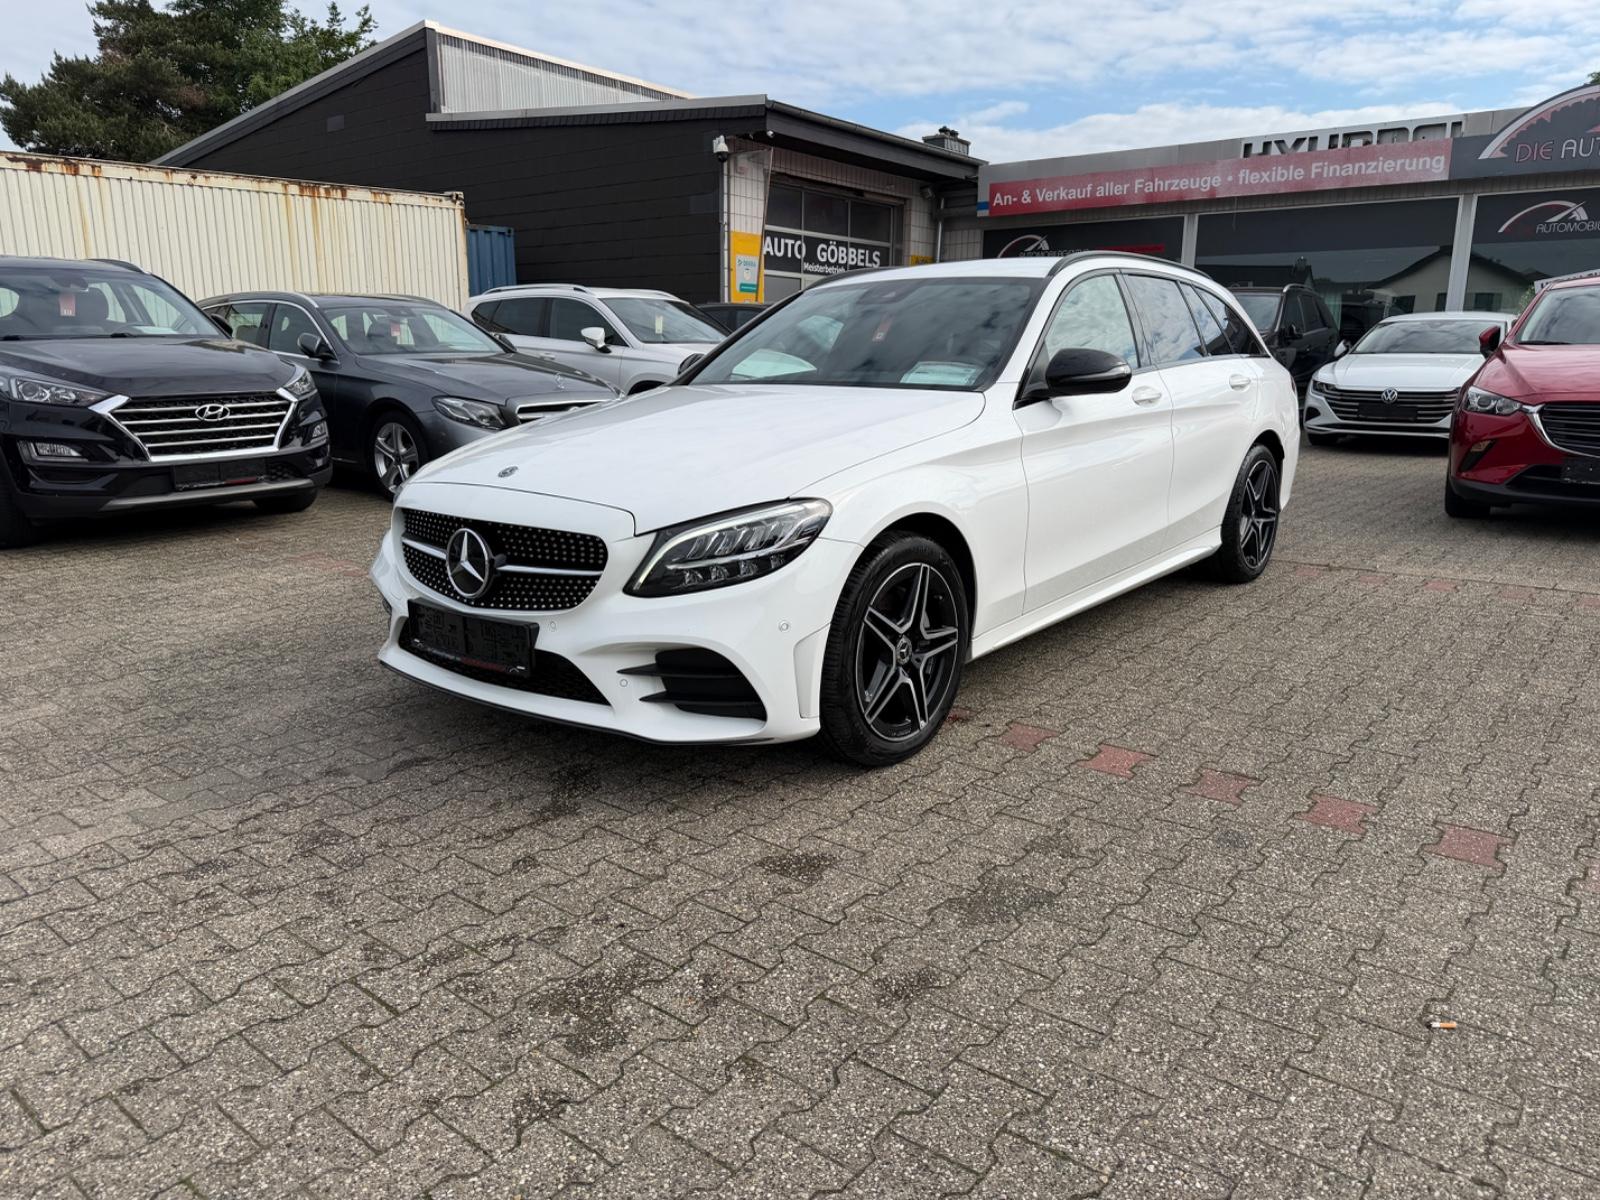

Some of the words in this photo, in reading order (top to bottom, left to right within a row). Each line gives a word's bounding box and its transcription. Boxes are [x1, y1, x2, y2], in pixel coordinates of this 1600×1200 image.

[1515, 141, 1553, 162] DIE
[993, 192, 1017, 207] An-
[1021, 190, 1031, 203] &
[1036, 183, 1093, 202] Verkauf
[1096, 181, 1129, 197] aller
[1134, 174, 1221, 194] Fahrzeuge
[1238, 165, 1305, 185] flexible
[1311, 154, 1445, 179] Finanzierung
[764, 236, 806, 259] AUTO
[816, 241, 881, 268] GÖBBELS
